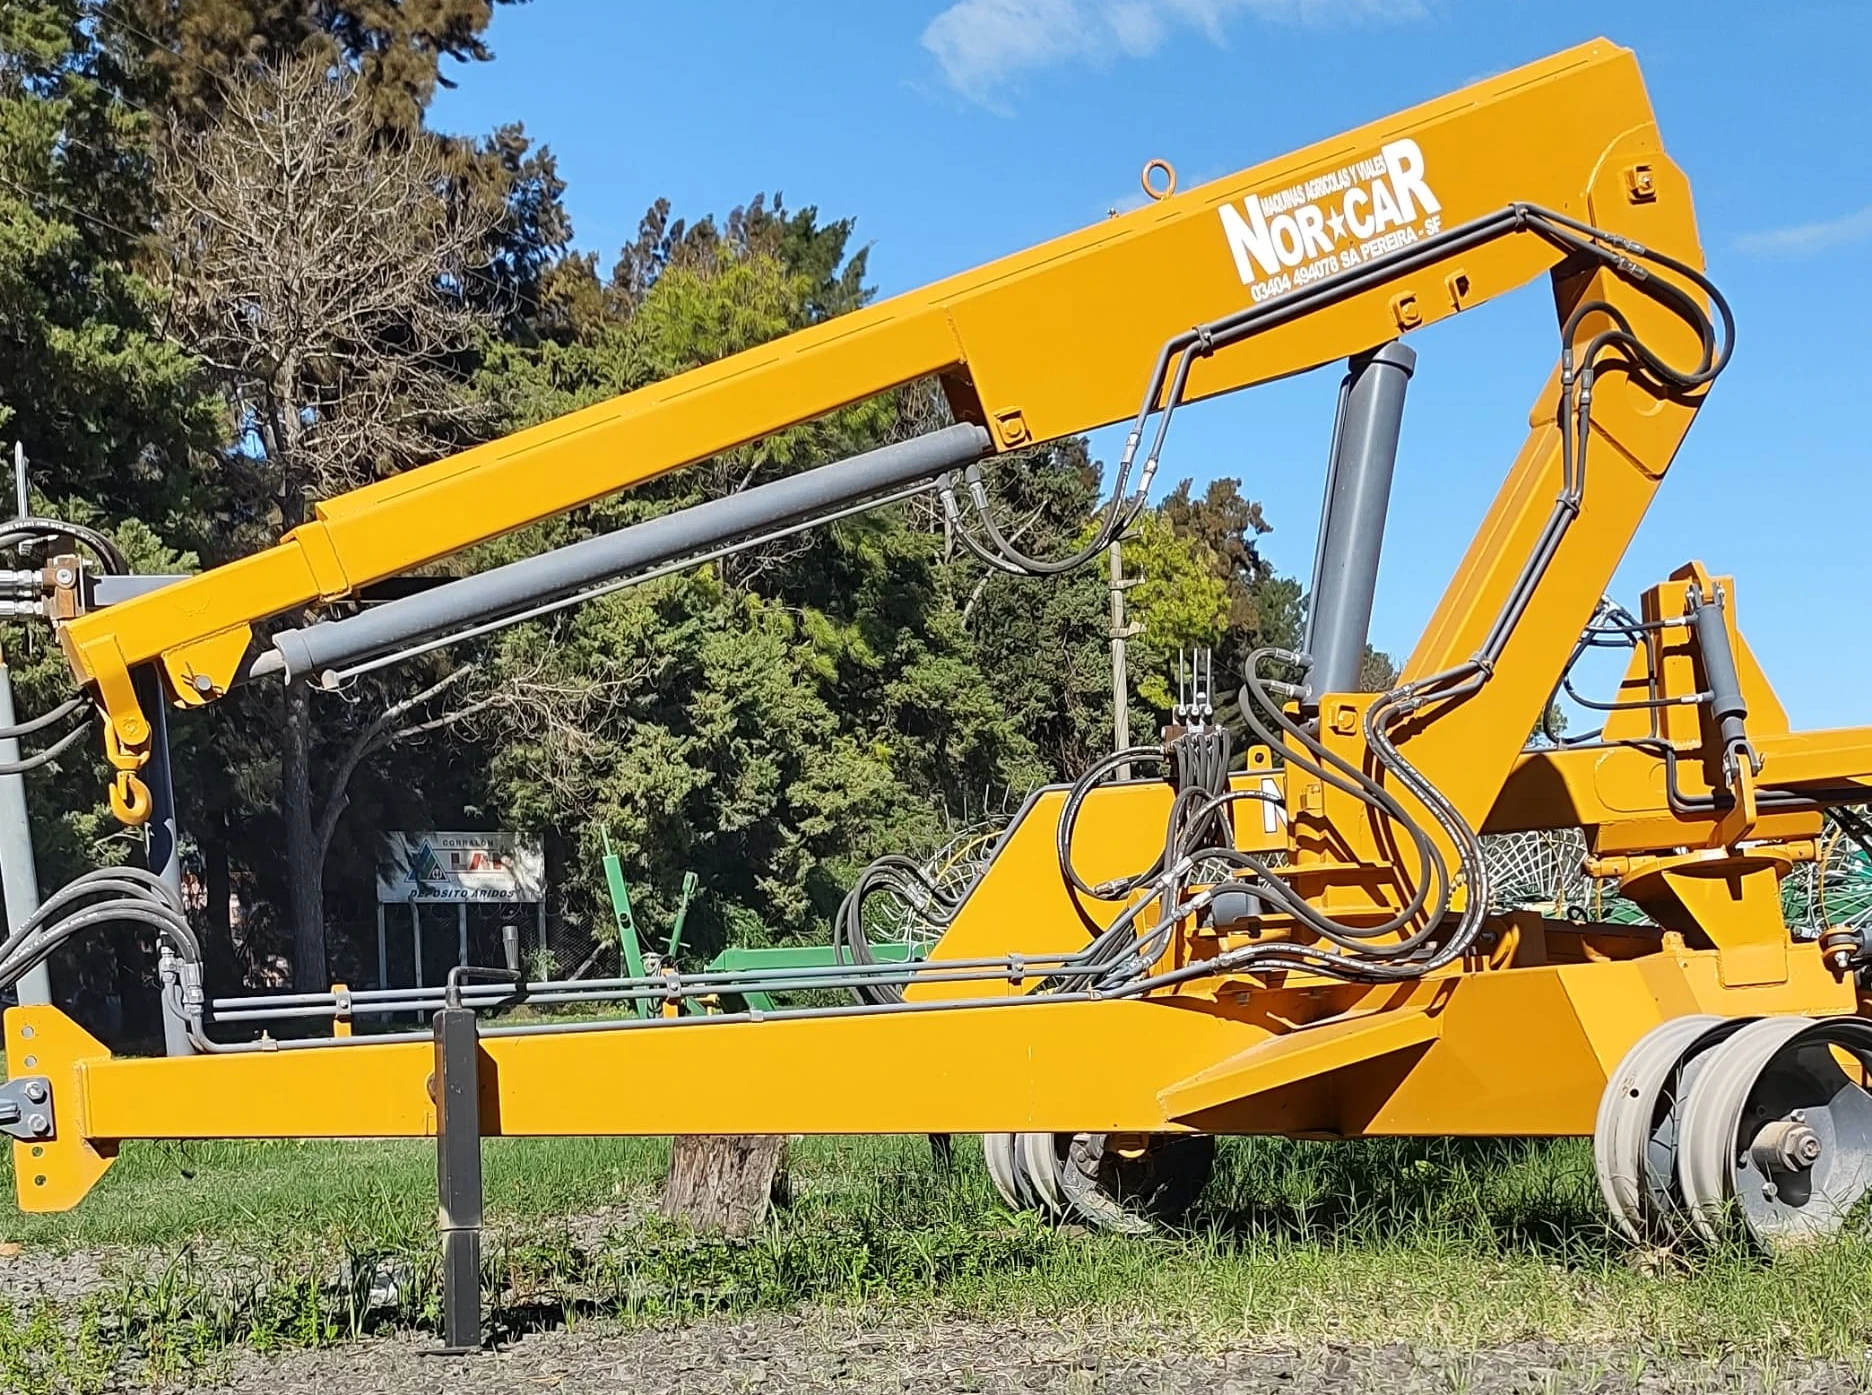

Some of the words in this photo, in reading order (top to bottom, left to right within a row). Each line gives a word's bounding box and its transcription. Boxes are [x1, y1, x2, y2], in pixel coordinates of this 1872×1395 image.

[1251, 275, 1291, 301] 03404
[1294, 256, 1338, 286] 494078
[1360, 227, 1417, 259] PEREIRA
[1424, 215, 1442, 236] SF
